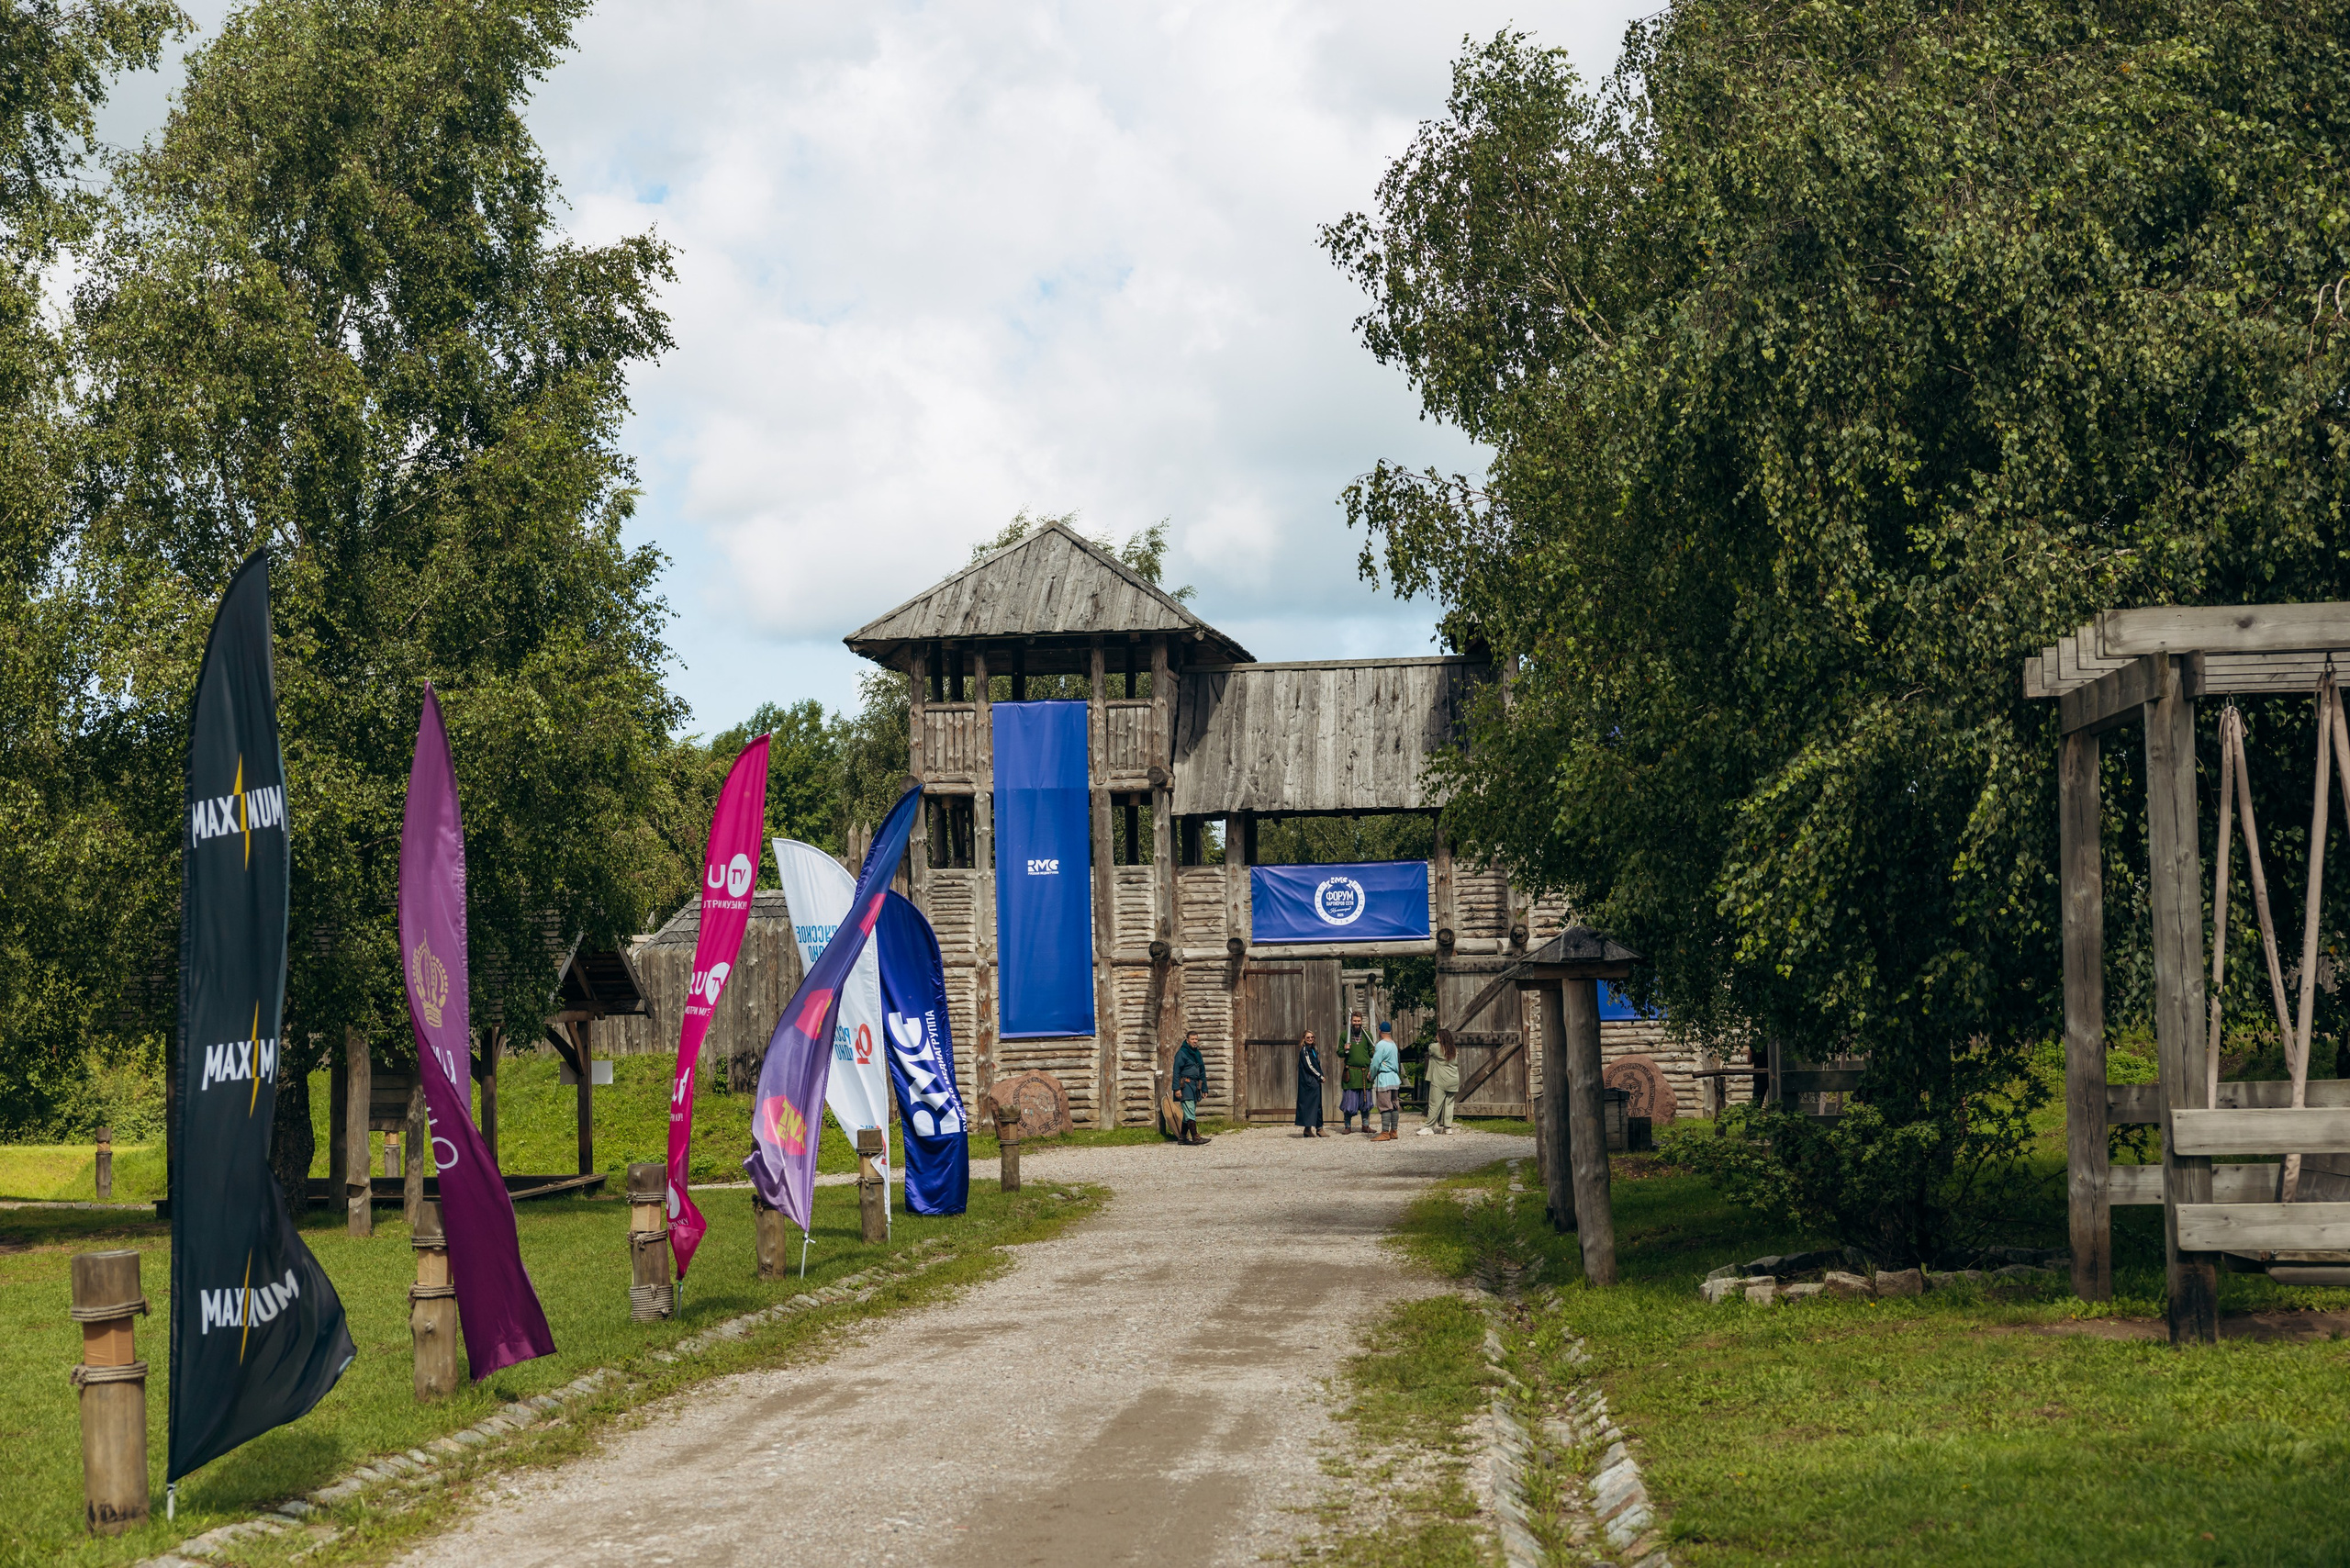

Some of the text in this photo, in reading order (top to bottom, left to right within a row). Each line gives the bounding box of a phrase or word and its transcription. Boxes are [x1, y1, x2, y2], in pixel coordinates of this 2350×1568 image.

[192, 784, 285, 849] MAXIMUM
[1027, 859, 1059, 872] RMG
[1326, 890, 1354, 902] ФОРУМ
[889, 1011, 960, 1137] RMG
[925, 1010, 950, 1084] МЕДИАГРУППА
